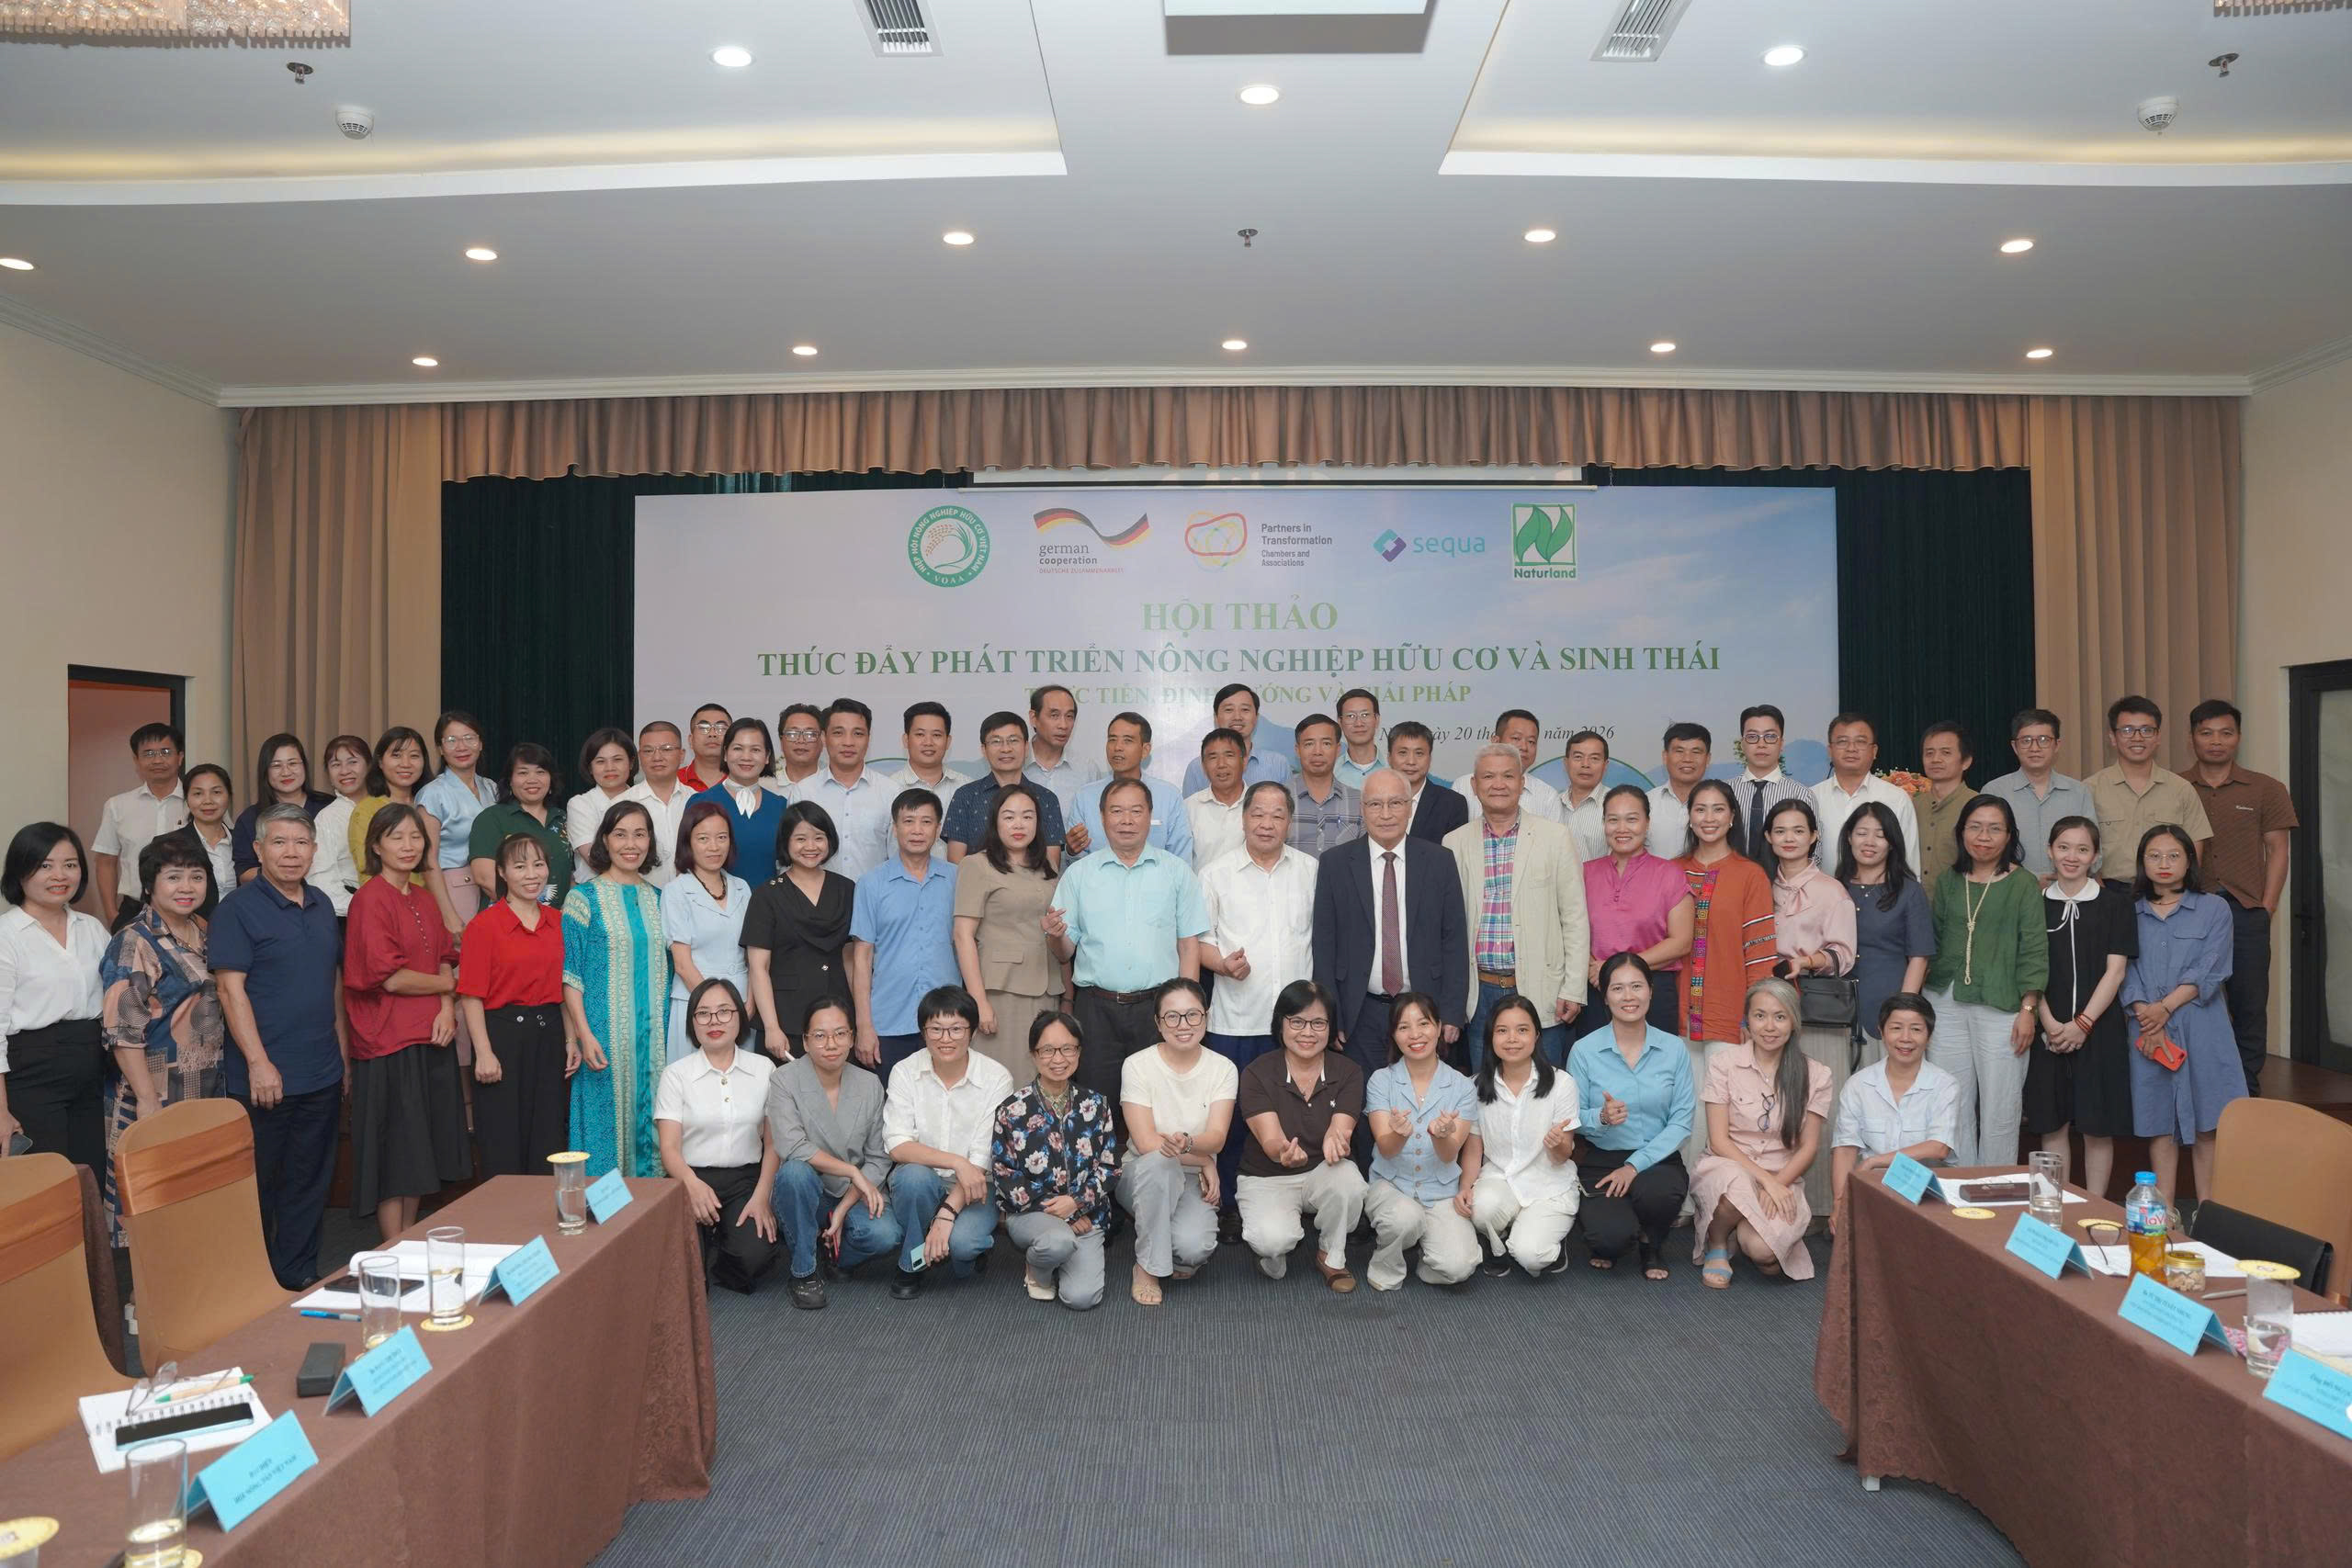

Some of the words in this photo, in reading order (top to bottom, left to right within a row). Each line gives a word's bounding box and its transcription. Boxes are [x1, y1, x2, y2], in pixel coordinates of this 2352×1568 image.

[1261, 523, 1301, 533] Partners
[1303, 523, 1312, 533] in
[1261, 535, 1333, 545] Transformation
[1039, 544, 1090, 557] german
[1261, 549, 1295, 558] Chambers
[1296, 549, 1310, 558] and
[1413, 536, 1486, 558] sequa
[970, 553, 985, 573] NAM
[1039, 556, 1098, 566] cooperation
[1261, 558, 1305, 567] Associations
[1513, 567, 1577, 579] Naturland
[1141, 598, 1216, 638] HỘI
[1226, 594, 1339, 631] THẢO
[757, 645, 846, 676] THÚC
[932, 643, 1018, 673] PHÁT
[1024, 643, 1125, 673] TRIỂN
[1135, 641, 1231, 672] NÔNG
[1239, 645, 1364, 678] NGHIỆP
[1372, 642, 1443, 671] HỮU
[1452, 646, 1499, 671] CƠ
[1507, 640, 1552, 671] VÀ
[1560, 647, 1635, 671] SINH
[1643, 639, 1721, 670] THÁI
[1360, 681, 1407, 703] IẢI
[1413, 682, 1471, 703] PHÁP
[1432, 727, 1451, 744] ày
[1454, 727, 1473, 740] 20
[1544, 727, 1575, 739] năm
